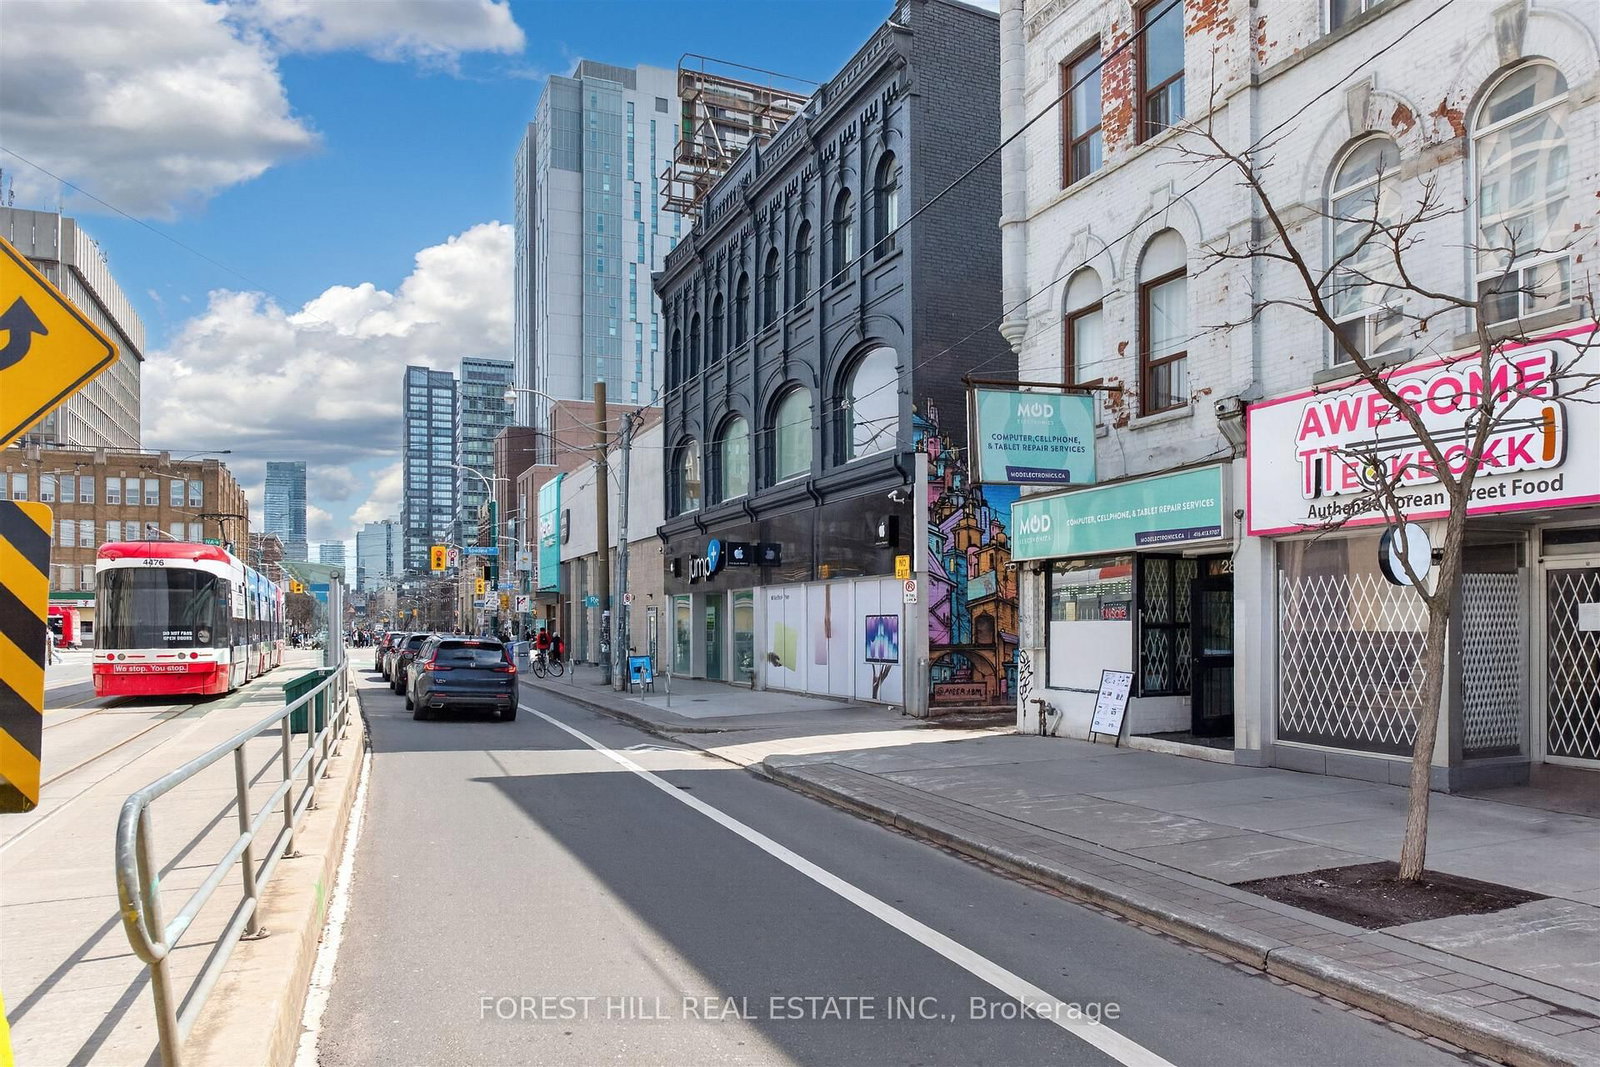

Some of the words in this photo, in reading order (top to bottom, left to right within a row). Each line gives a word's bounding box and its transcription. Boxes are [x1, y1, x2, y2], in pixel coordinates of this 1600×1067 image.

[1299, 356, 1547, 441] AWESOME
[1017, 402, 1054, 418] MOD
[995, 443, 1020, 451] TABLET
[1022, 444, 1049, 452] REPAIR
[1050, 445, 1086, 453] SERVICES
[1466, 481, 1507, 501] reet
[1511, 472, 1564, 496] Food
[1066, 514, 1096, 527] COMPUTER,
[1096, 510, 1132, 523] CELLPHONE,
[1137, 507, 1158, 517] TABLET
[1159, 503, 1182, 513] REPAIR
[1182, 498, 1215, 511] SERVICES
[1019, 514, 1051, 535] MOD
[142, 559, 165, 567] 4476
[898, 559, 907, 567] NO
[897, 569, 909, 577] EXIT
[115, 664, 128, 672] We
[129, 665, 147, 673] stop.
[151, 664, 166, 672] You
[166, 664, 187, 672] stop.
